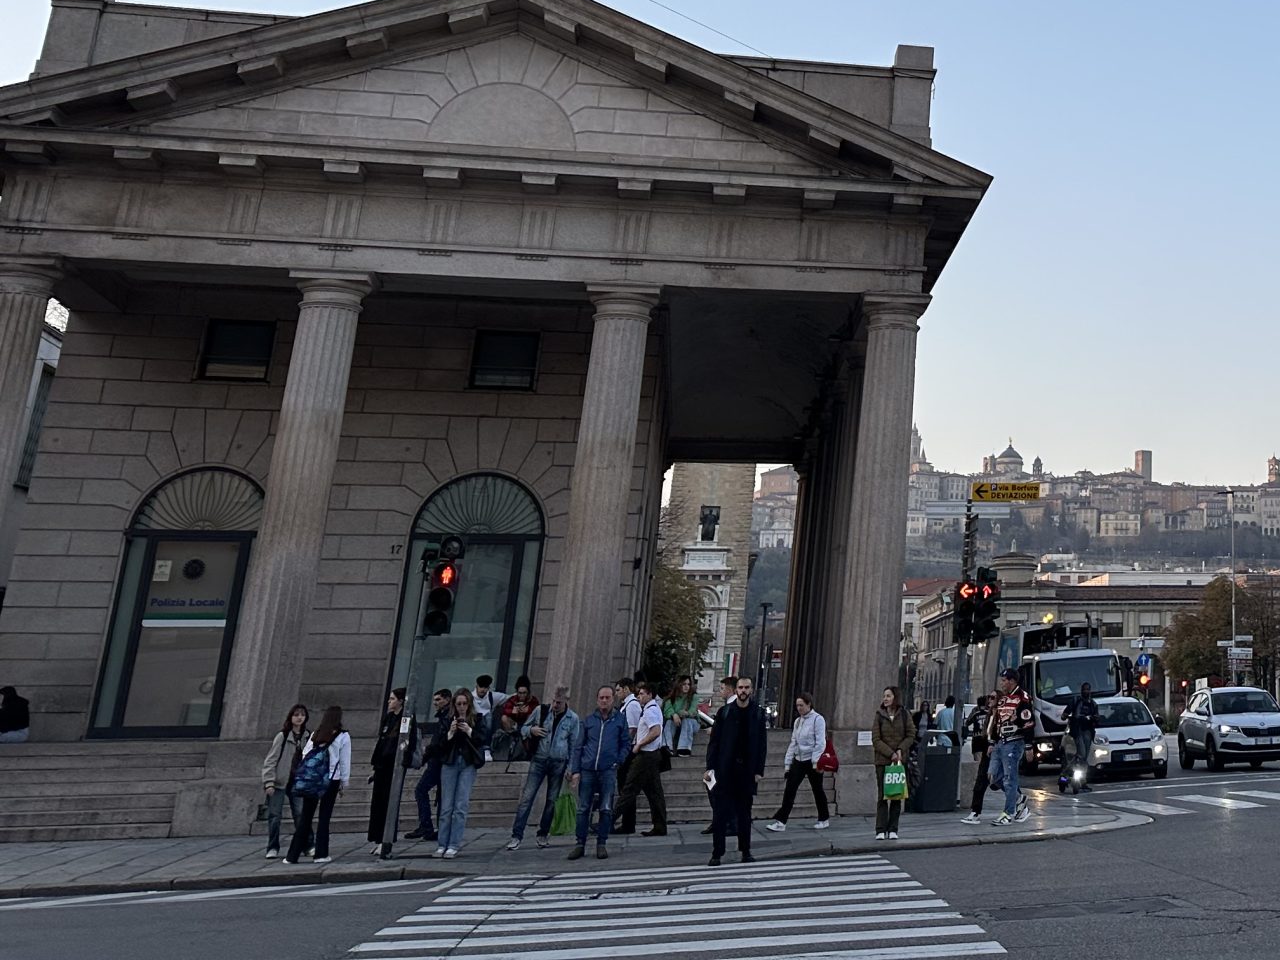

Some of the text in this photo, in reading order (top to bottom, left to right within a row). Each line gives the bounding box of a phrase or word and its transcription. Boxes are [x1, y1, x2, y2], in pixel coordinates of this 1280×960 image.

[391, 544, 403, 554] 17
[150, 598, 225, 607] Polizia Locale
